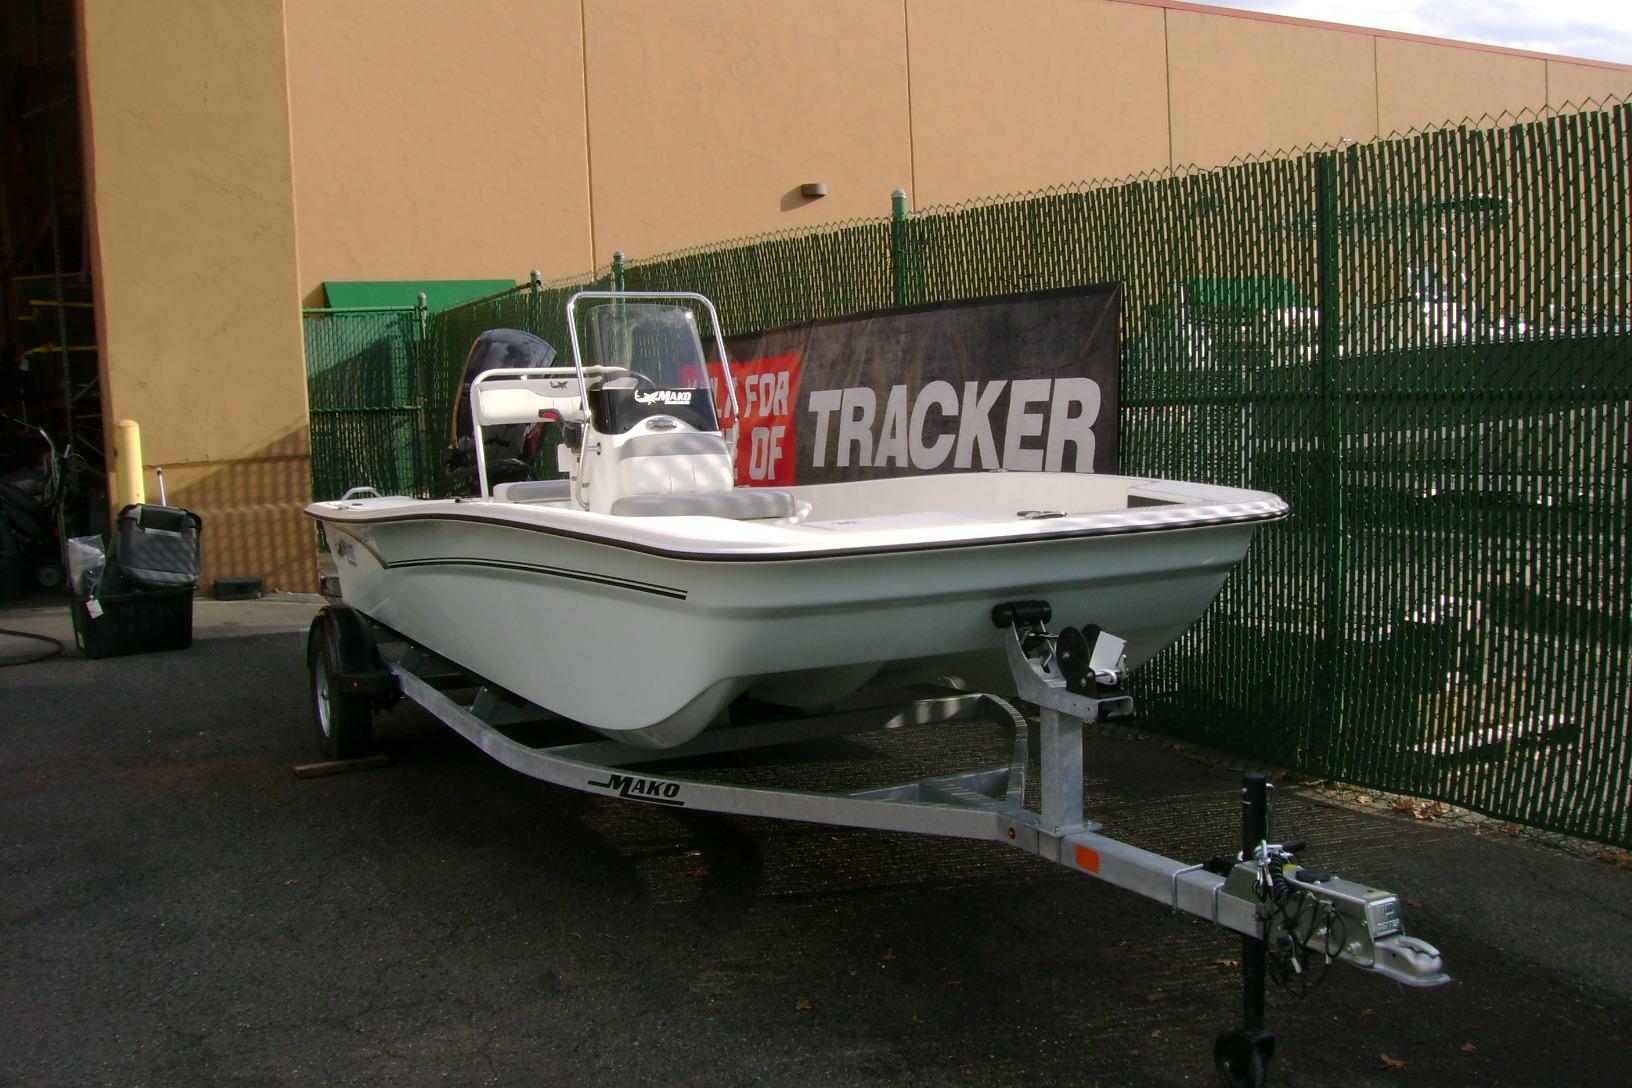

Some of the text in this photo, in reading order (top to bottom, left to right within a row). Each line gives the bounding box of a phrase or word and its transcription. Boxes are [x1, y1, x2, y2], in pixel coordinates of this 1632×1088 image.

[657, 390, 692, 404] MAKO
[744, 371, 789, 418] FOR
[808, 377, 1101, 474] TRACKER
[748, 425, 786, 480] OF
[602, 774, 684, 802] MAKO
